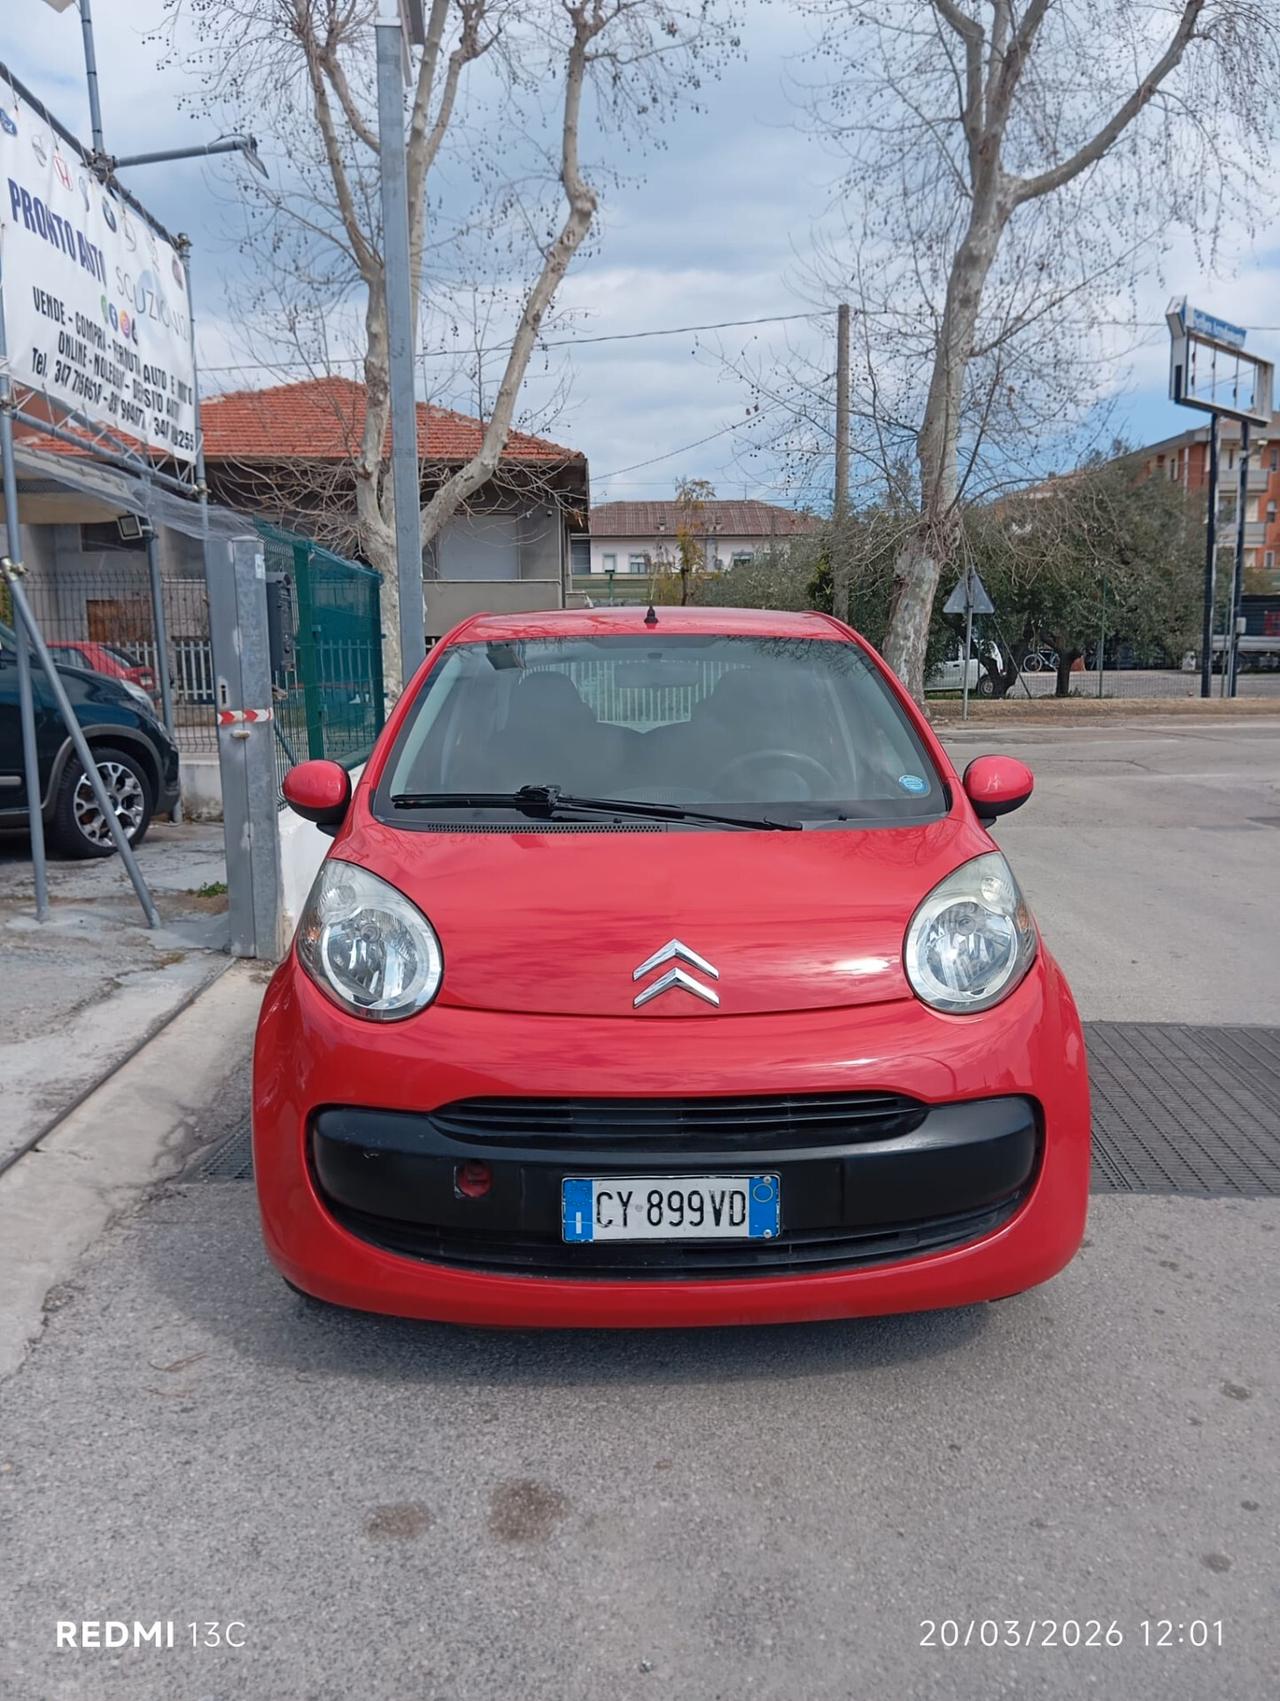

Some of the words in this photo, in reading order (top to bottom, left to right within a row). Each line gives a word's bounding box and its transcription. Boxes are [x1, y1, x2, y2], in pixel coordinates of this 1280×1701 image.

[8, 177, 76, 262] PRONTO
[33, 286, 66, 326] VENDE
[143, 364, 167, 390] AUTO
[596, 1191, 633, 1228] CY
[647, 1189, 746, 1228] 899VD
